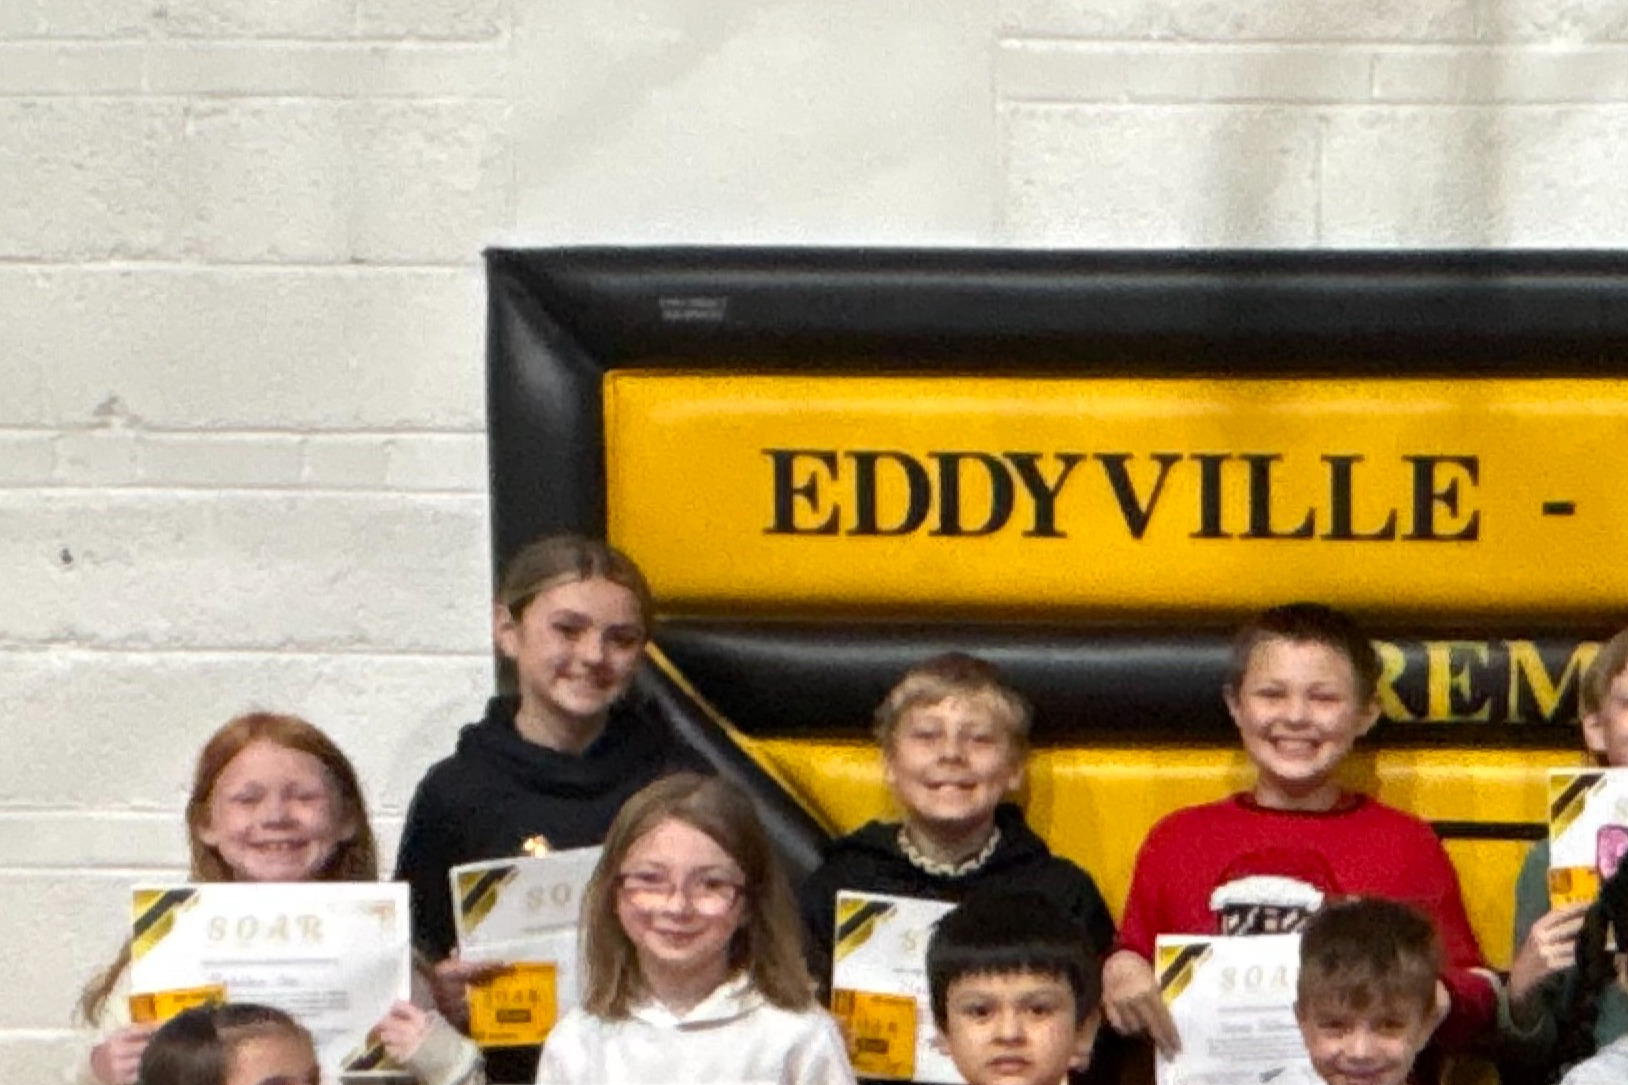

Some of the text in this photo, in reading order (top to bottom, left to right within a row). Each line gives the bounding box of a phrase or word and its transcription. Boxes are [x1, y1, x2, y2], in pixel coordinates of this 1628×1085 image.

[761, 448, 1481, 543] EDDYVILLE
[206, 914, 324, 942] SOAR
[1219, 963, 1290, 992] SOA
